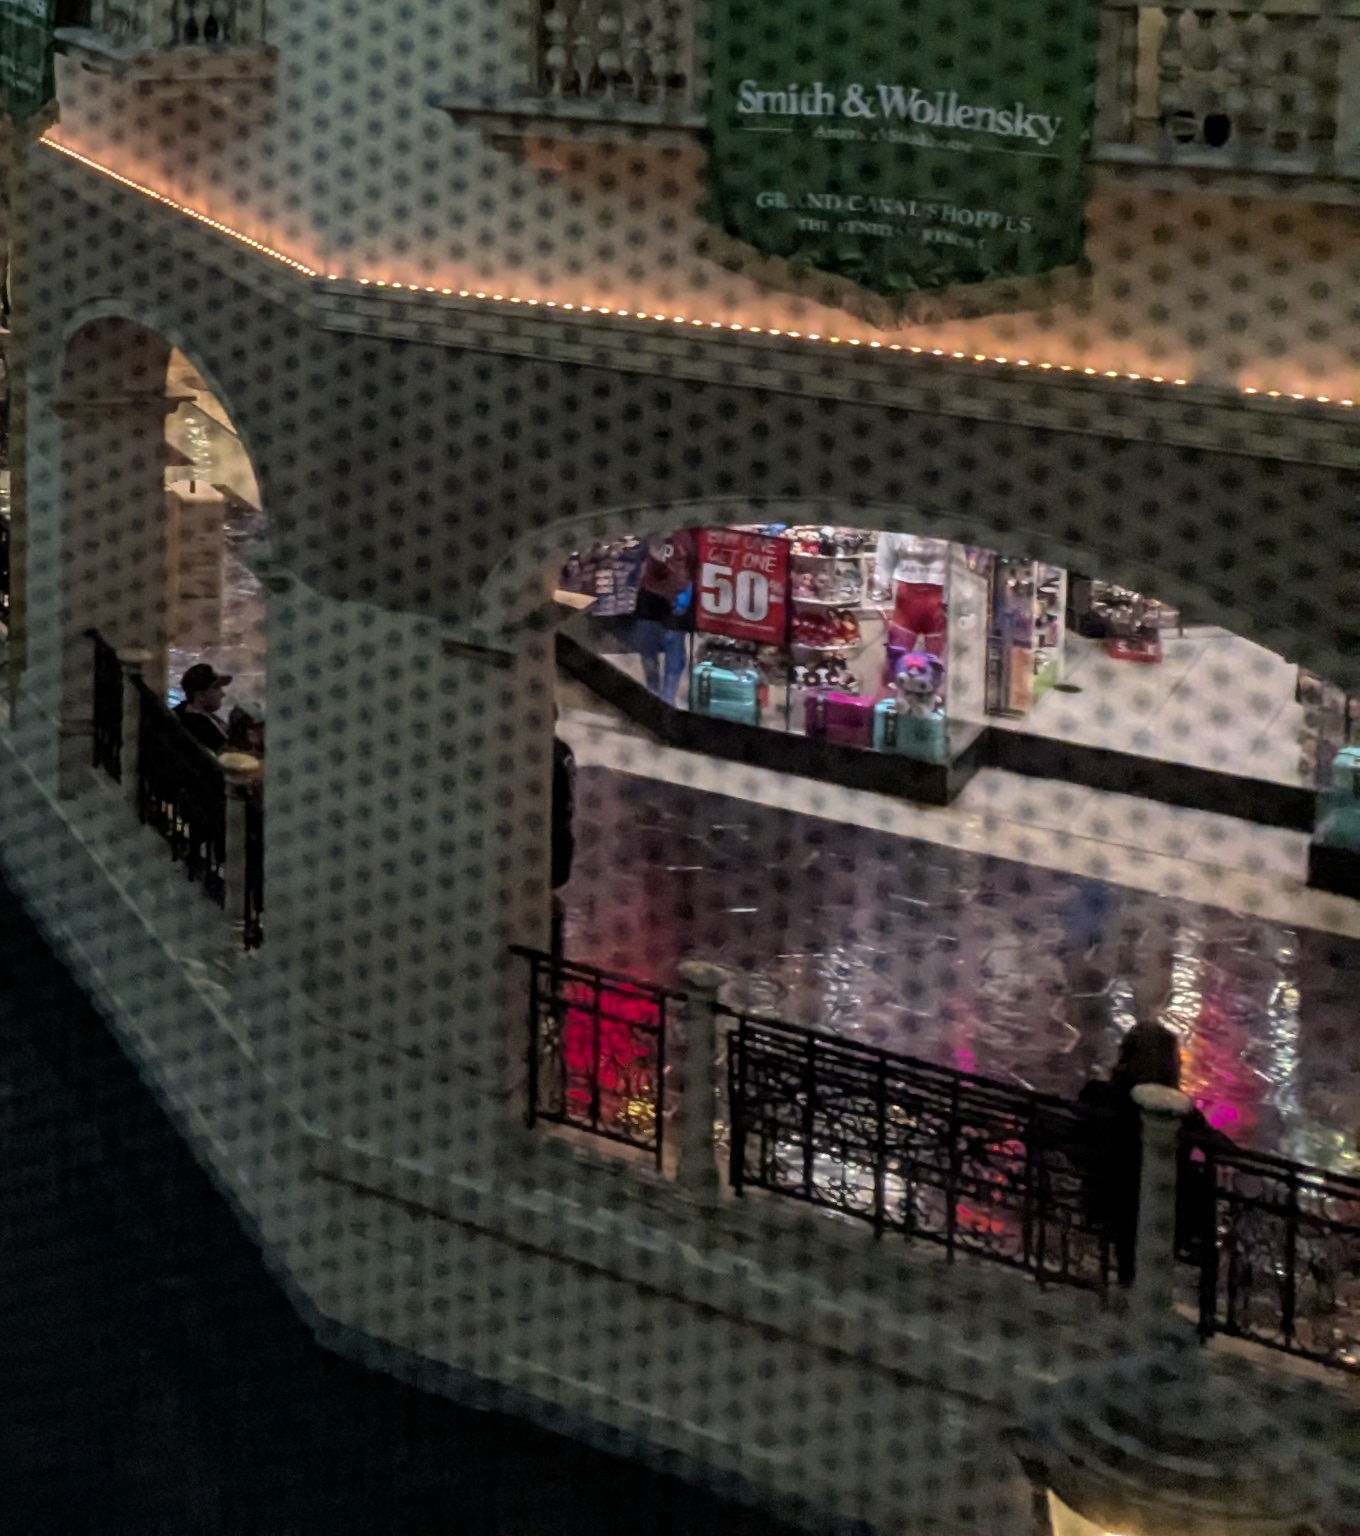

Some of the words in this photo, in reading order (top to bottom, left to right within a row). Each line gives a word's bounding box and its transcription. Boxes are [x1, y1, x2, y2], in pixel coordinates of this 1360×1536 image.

[737, 78, 835, 116] Smith
[841, 82, 877, 119] &
[877, 83, 1062, 145] Wollensky
[700, 562, 770, 622] 50
[742, 552, 778, 573] ONE
